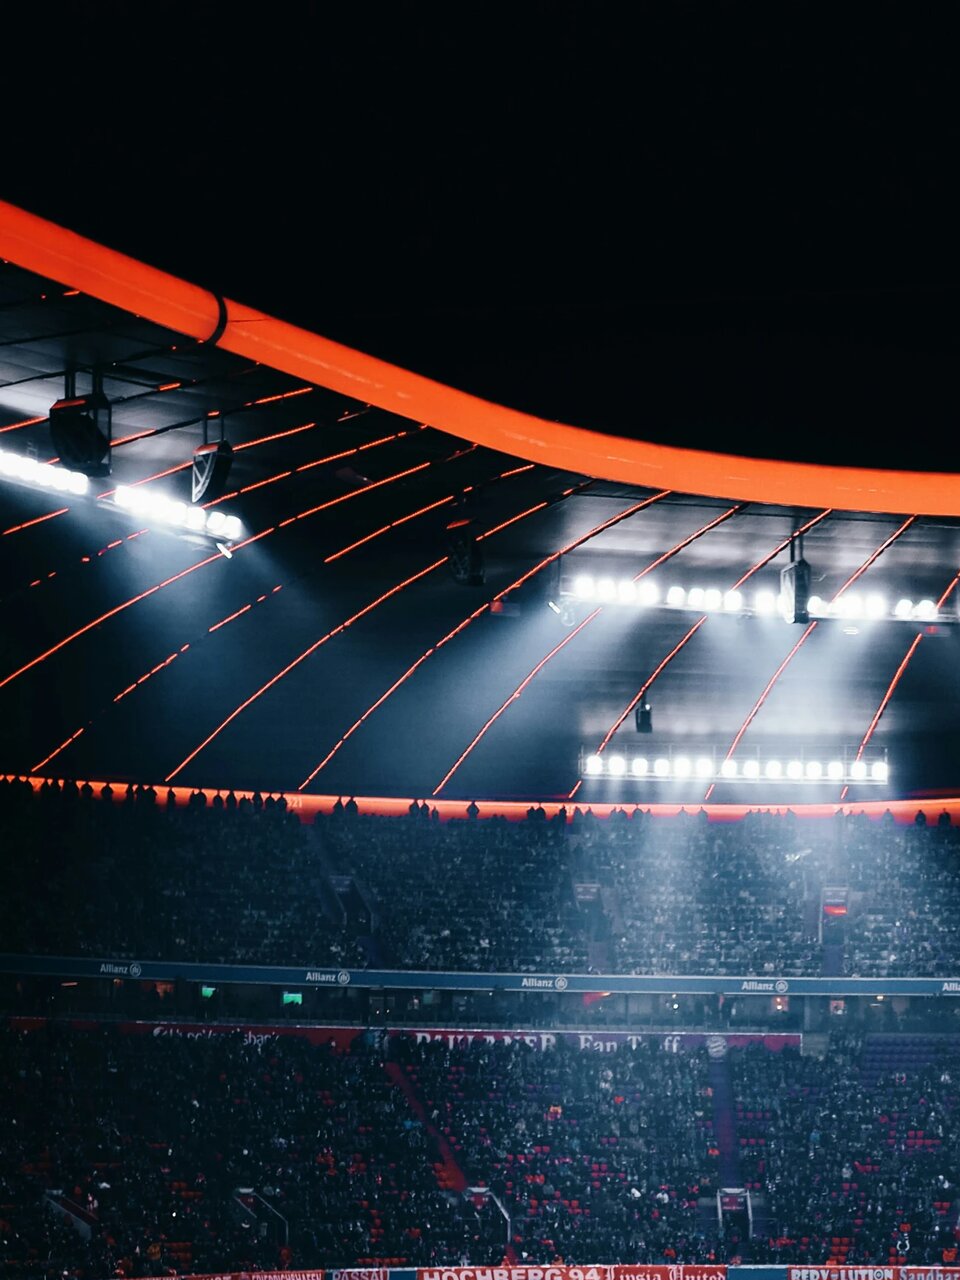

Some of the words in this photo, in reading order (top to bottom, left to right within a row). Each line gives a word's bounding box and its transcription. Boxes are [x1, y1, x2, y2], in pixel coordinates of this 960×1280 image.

[100, 964, 128, 975] Allianz
[306, 971, 336, 983] Allianz
[521, 977, 553, 989] Allianz
[742, 981, 774, 992] Allianz
